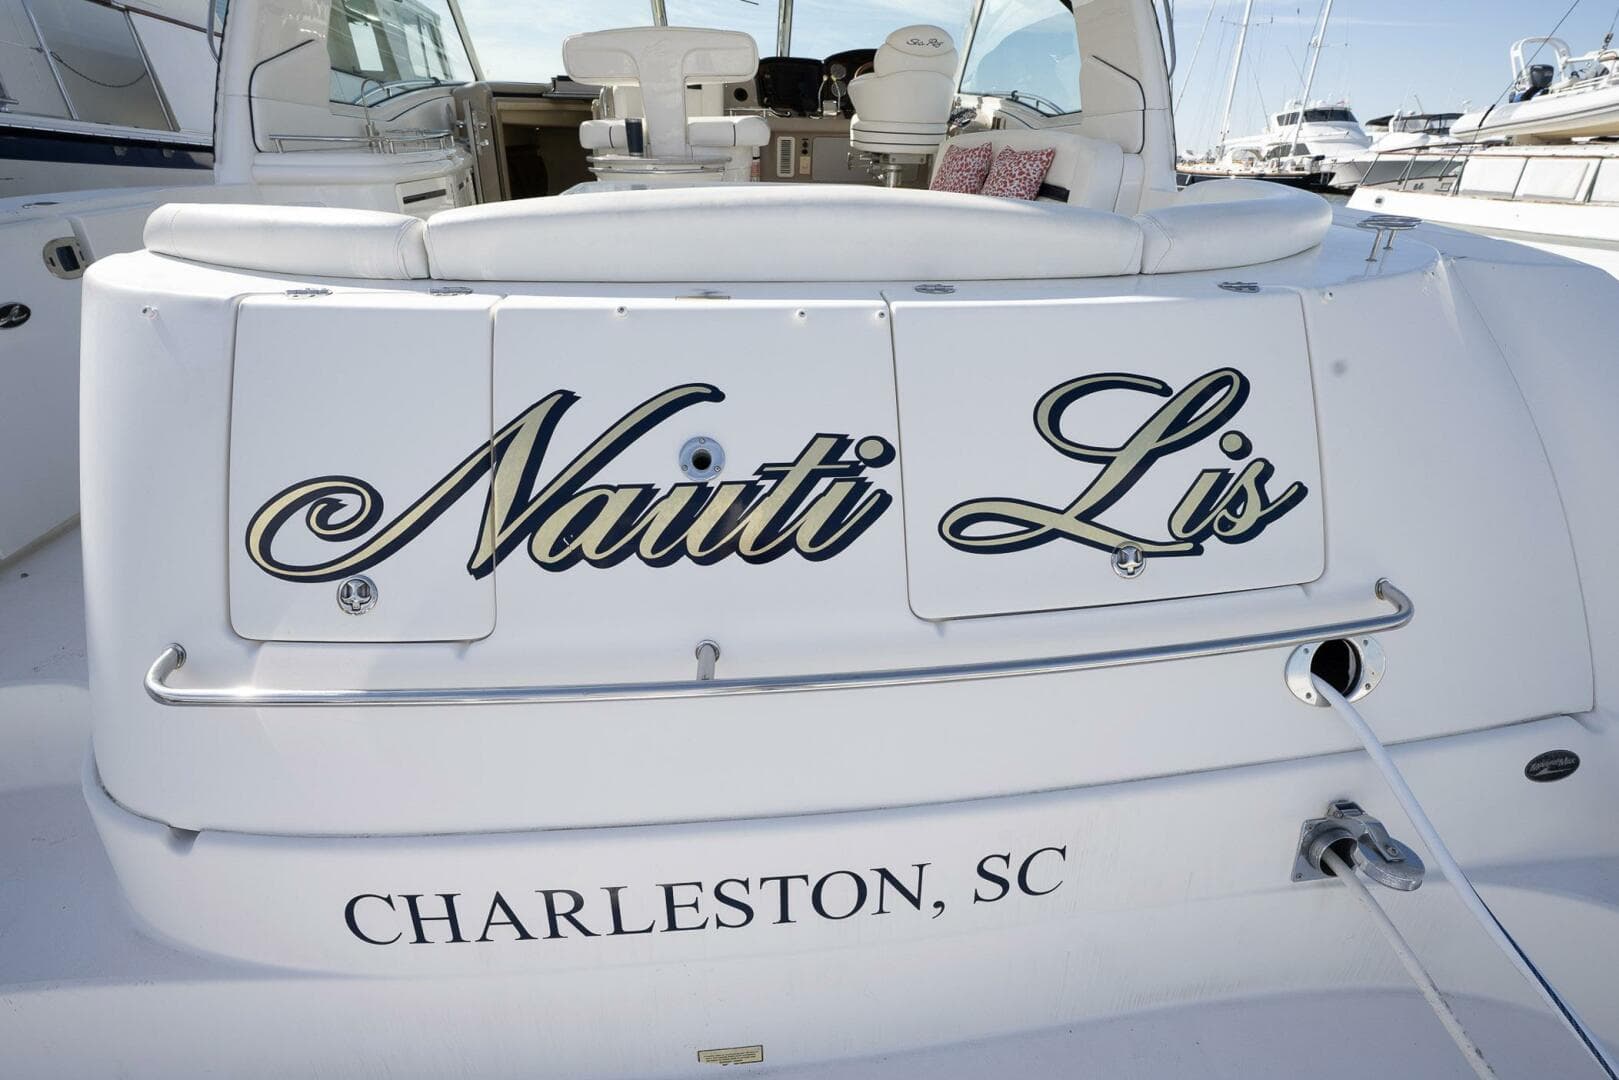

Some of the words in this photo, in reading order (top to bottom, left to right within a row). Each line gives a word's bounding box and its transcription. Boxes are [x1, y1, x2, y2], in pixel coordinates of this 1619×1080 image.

[906, 38, 924, 46] Sea
[926, 38, 944, 49] Ray
[245, 382, 896, 583] Nauti
[938, 367, 1309, 558] Lis
[344, 862, 946, 946] CHARLESTON,
[973, 845, 1068, 905] SC
